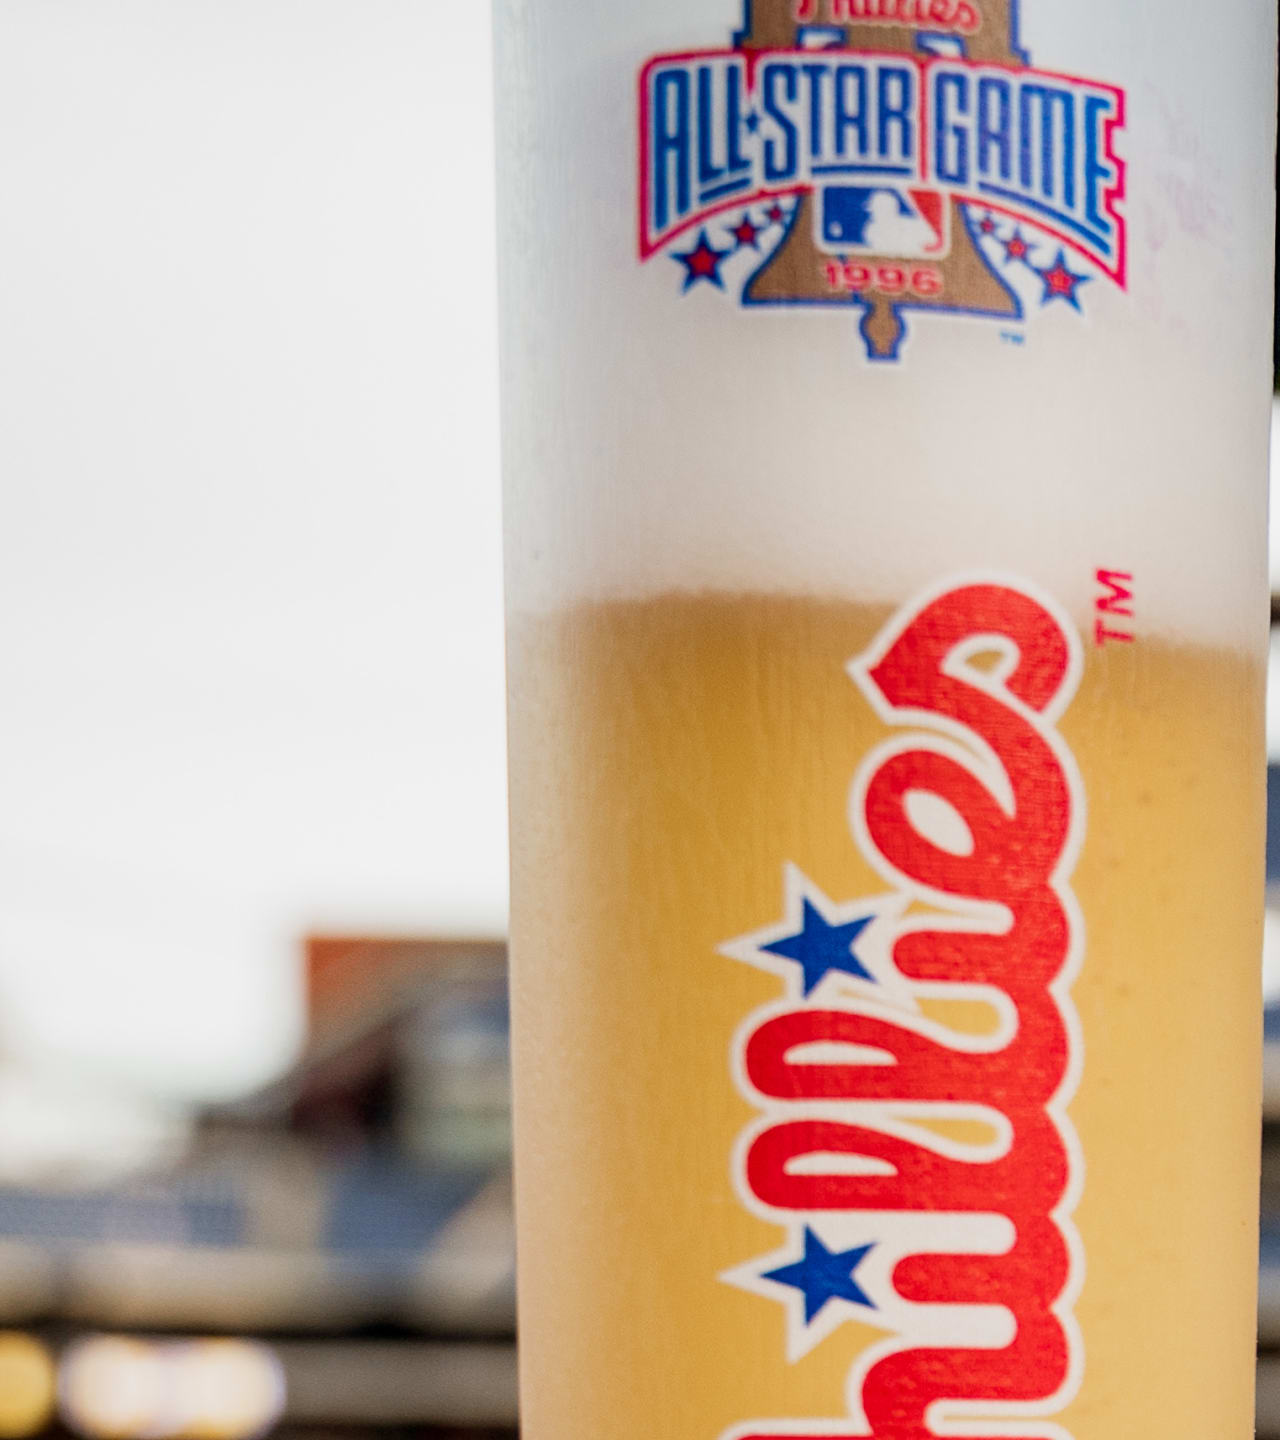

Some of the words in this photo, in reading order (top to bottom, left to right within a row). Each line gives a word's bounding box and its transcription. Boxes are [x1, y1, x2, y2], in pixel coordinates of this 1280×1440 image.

[935, 71, 1111, 235] GAME
[825, 260, 942, 295] 1996
[1096, 569, 1133, 647] TM
